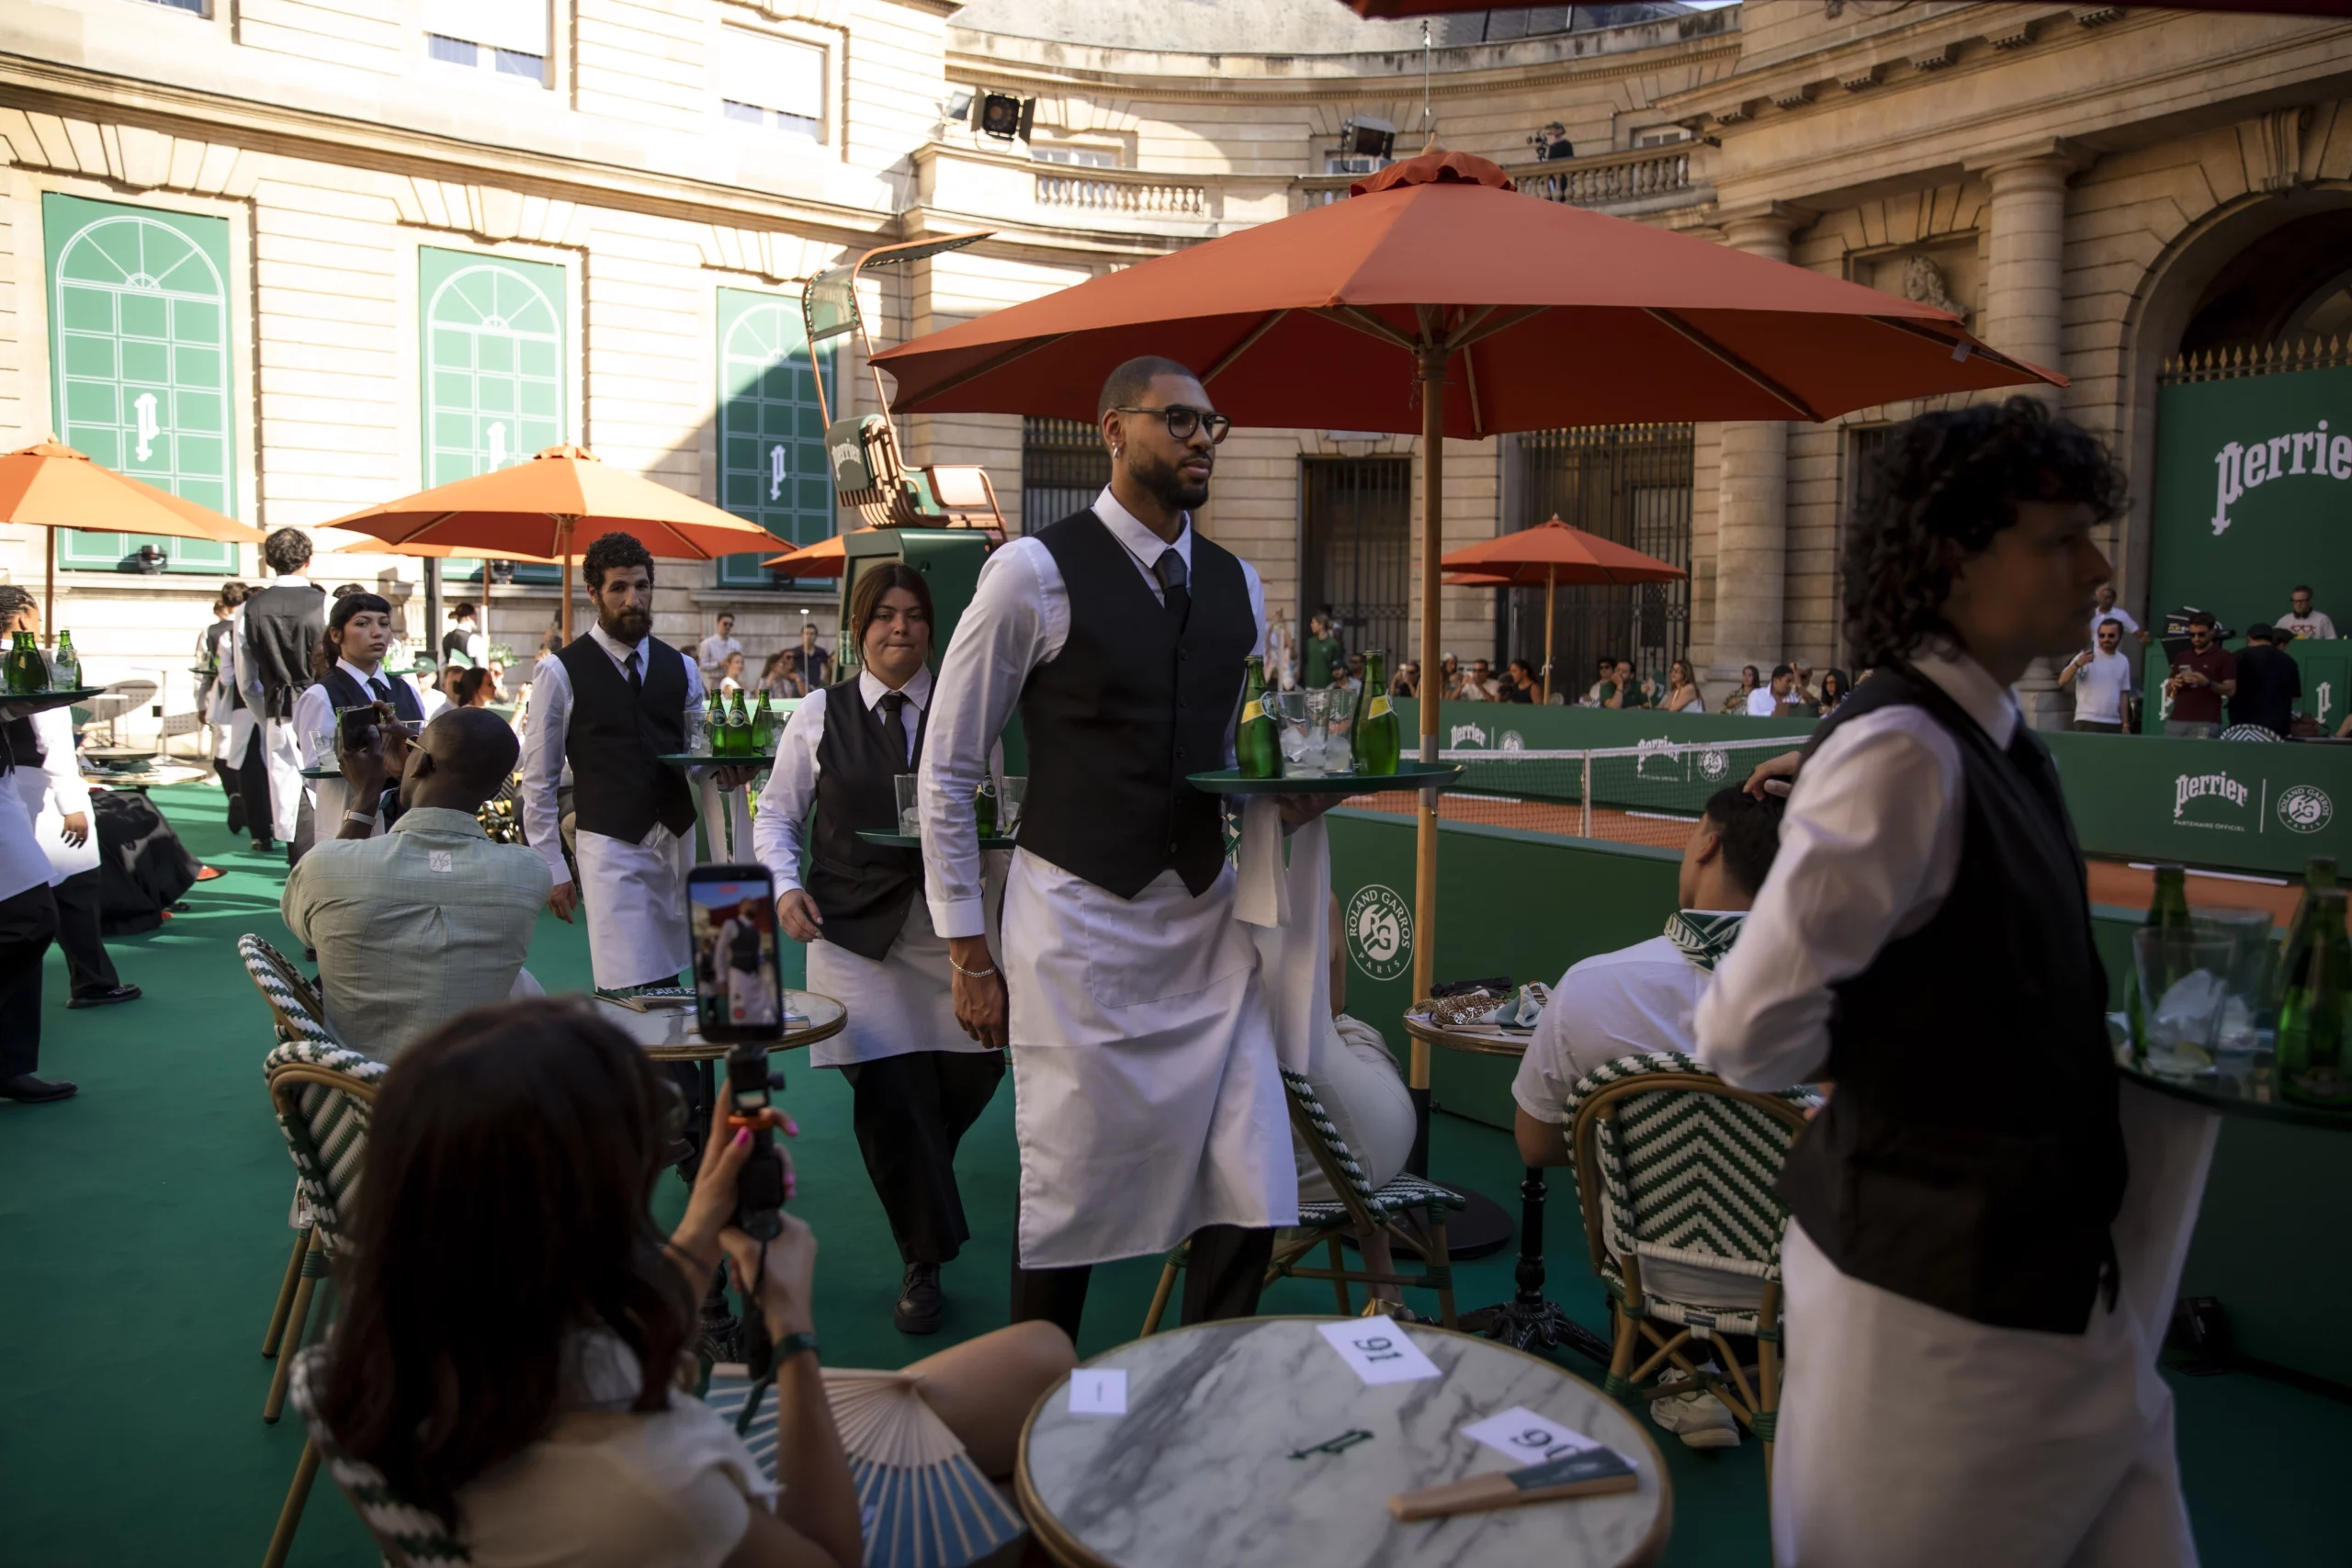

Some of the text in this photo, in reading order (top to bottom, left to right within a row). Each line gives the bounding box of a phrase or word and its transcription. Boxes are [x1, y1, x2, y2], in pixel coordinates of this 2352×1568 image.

[2280, 788, 2330, 816] ROLAND GARROS
[1349, 890, 1410, 948] ROLAND GARROS
[1358, 952, 1400, 974] PARIS
